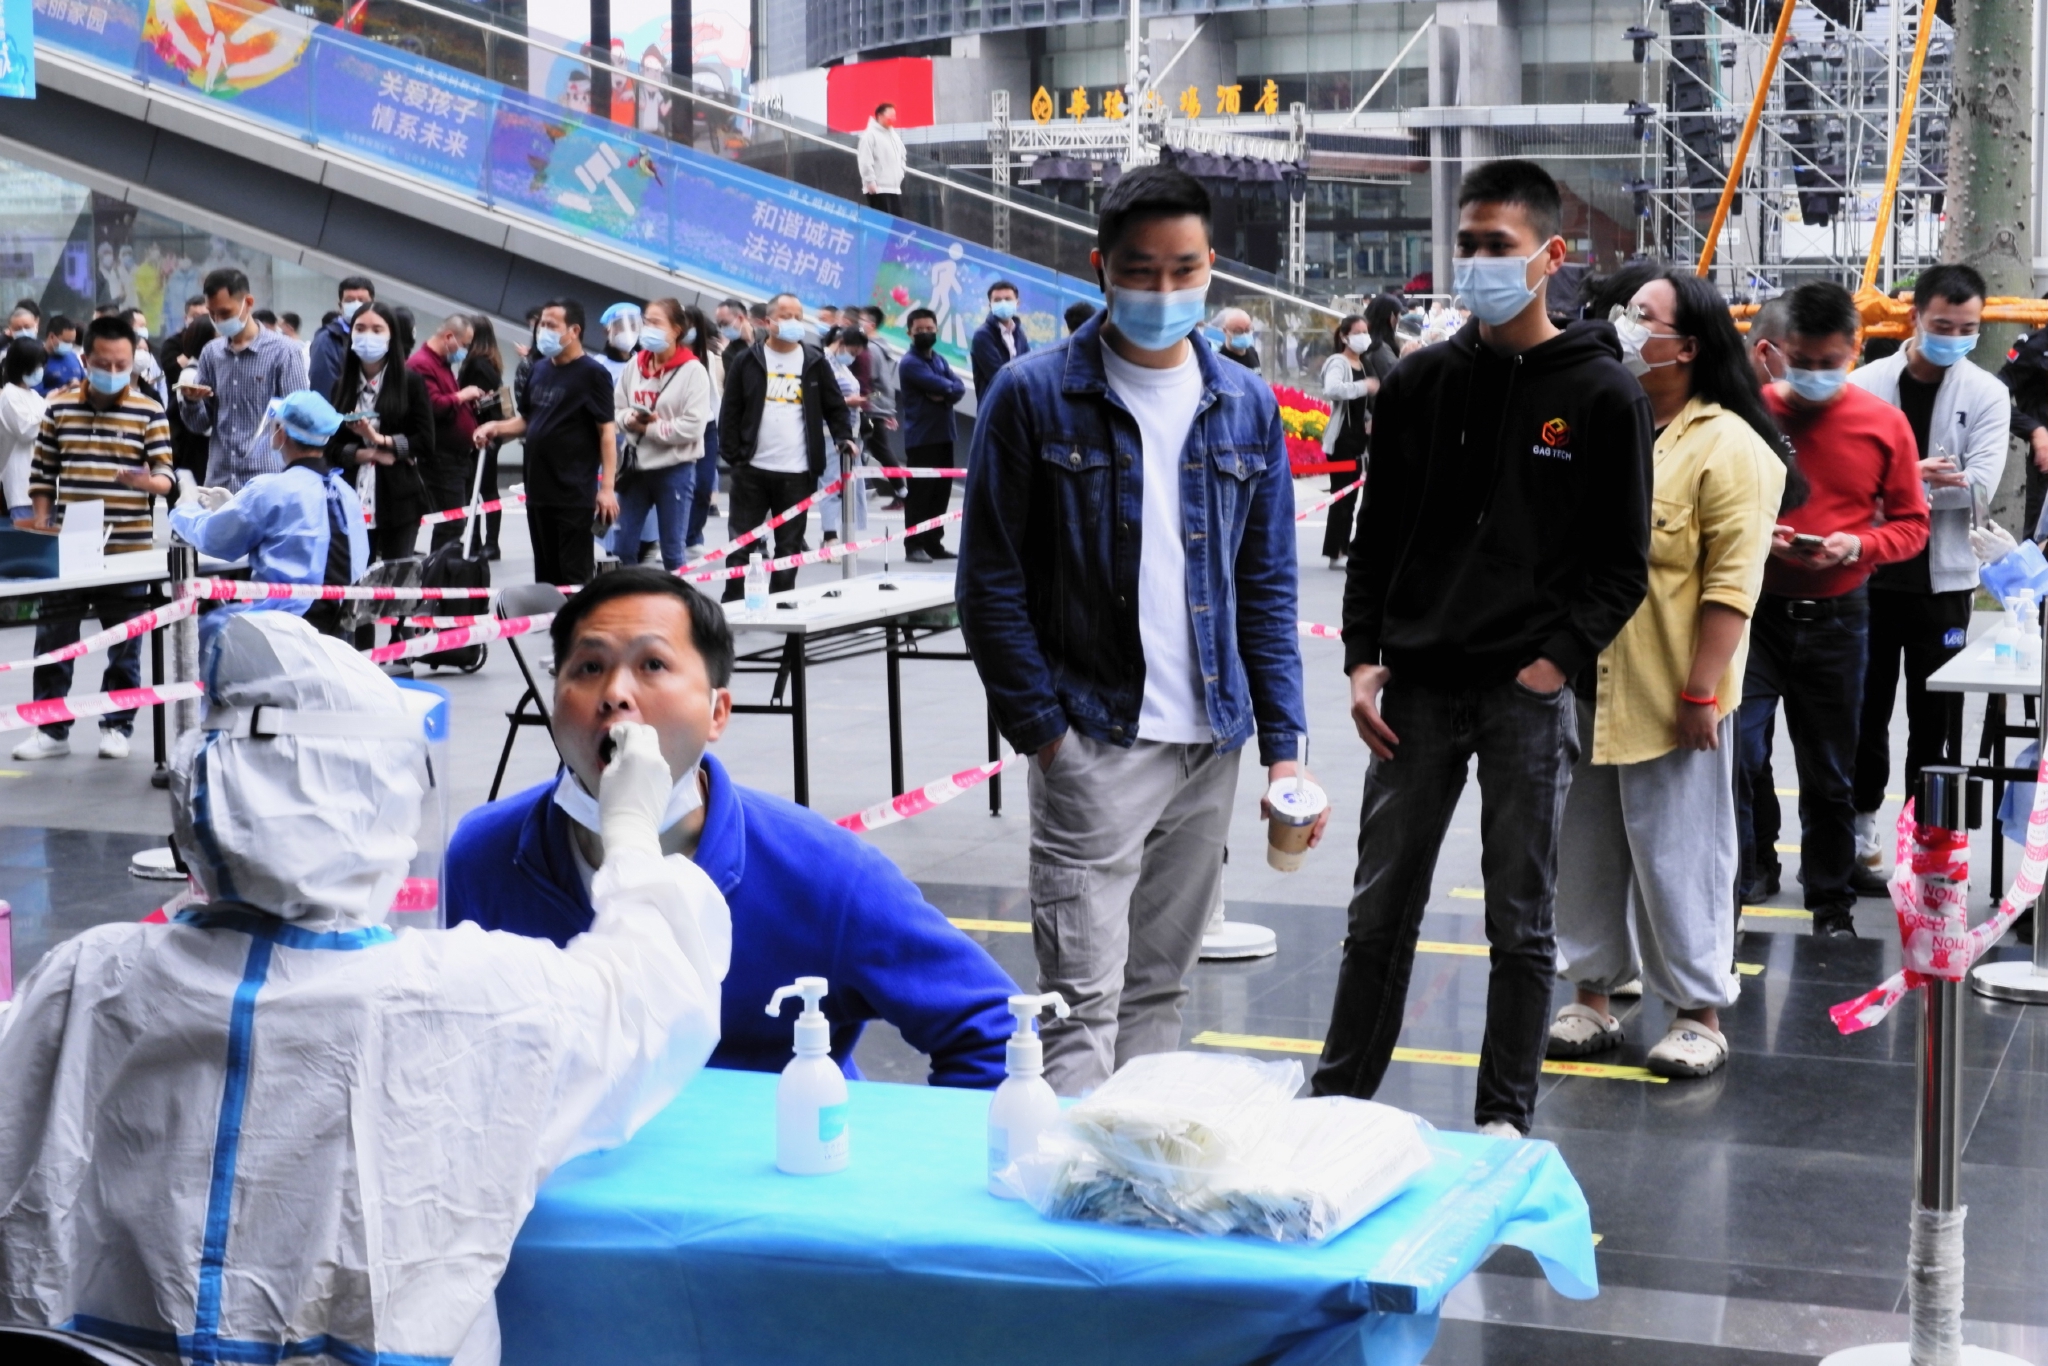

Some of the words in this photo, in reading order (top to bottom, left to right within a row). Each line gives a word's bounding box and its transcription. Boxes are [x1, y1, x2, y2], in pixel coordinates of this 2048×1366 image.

[378, 71, 477, 124] 关爱孩子
[371, 102, 469, 158] 情系未来
[752, 200, 854, 255] 和谐城市
[742, 231, 844, 289] 法治护航
[1944, 633, 1964, 646] Lee
